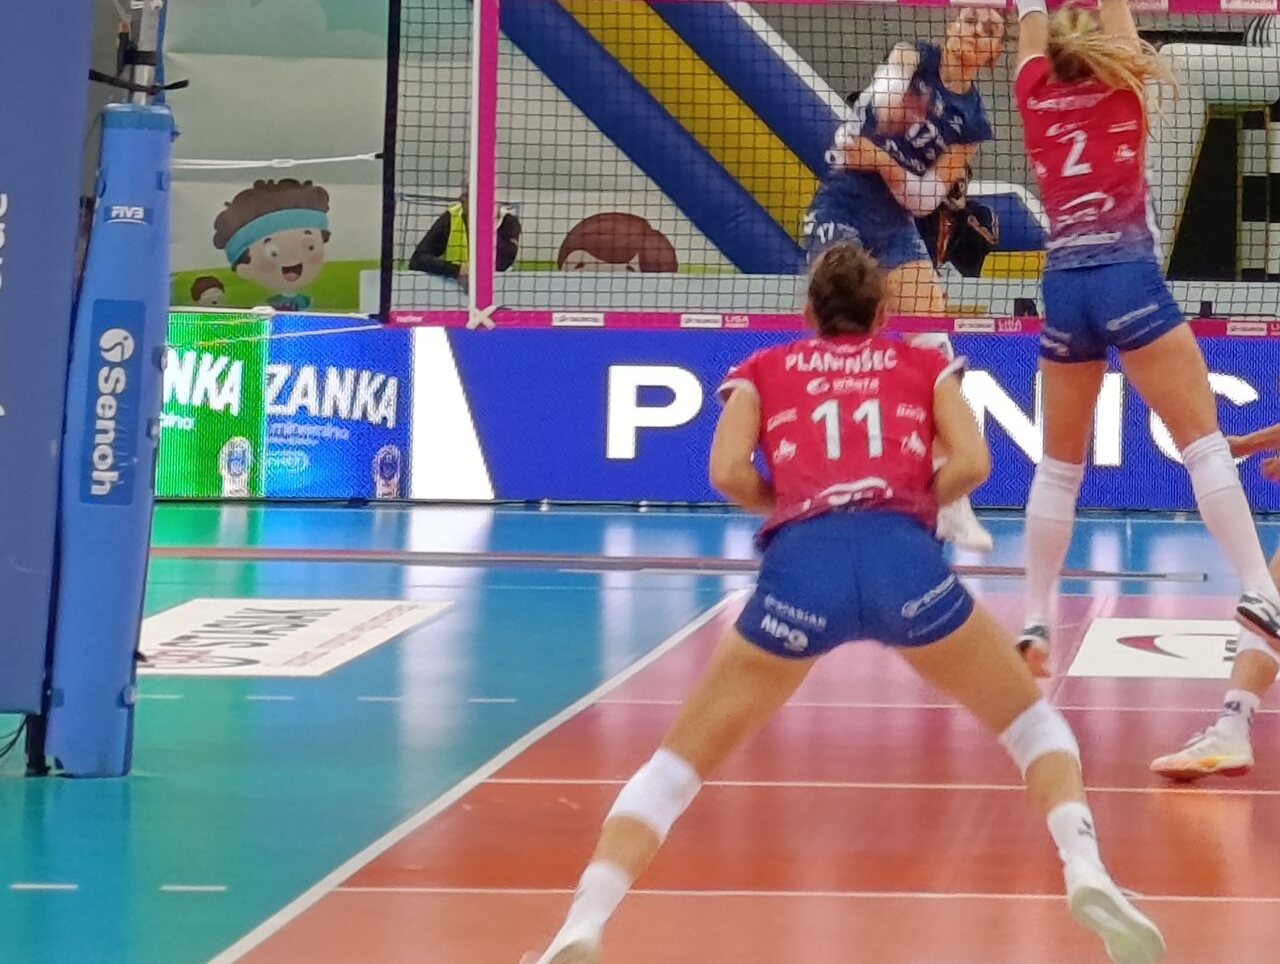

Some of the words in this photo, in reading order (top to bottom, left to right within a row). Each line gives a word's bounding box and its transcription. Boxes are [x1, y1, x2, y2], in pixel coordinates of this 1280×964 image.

[1056, 129, 1093, 177] 2
[267, 362, 399, 429] ZANKA
[90, 366, 126, 497] Senoh
[810, 399, 884, 460] 11
